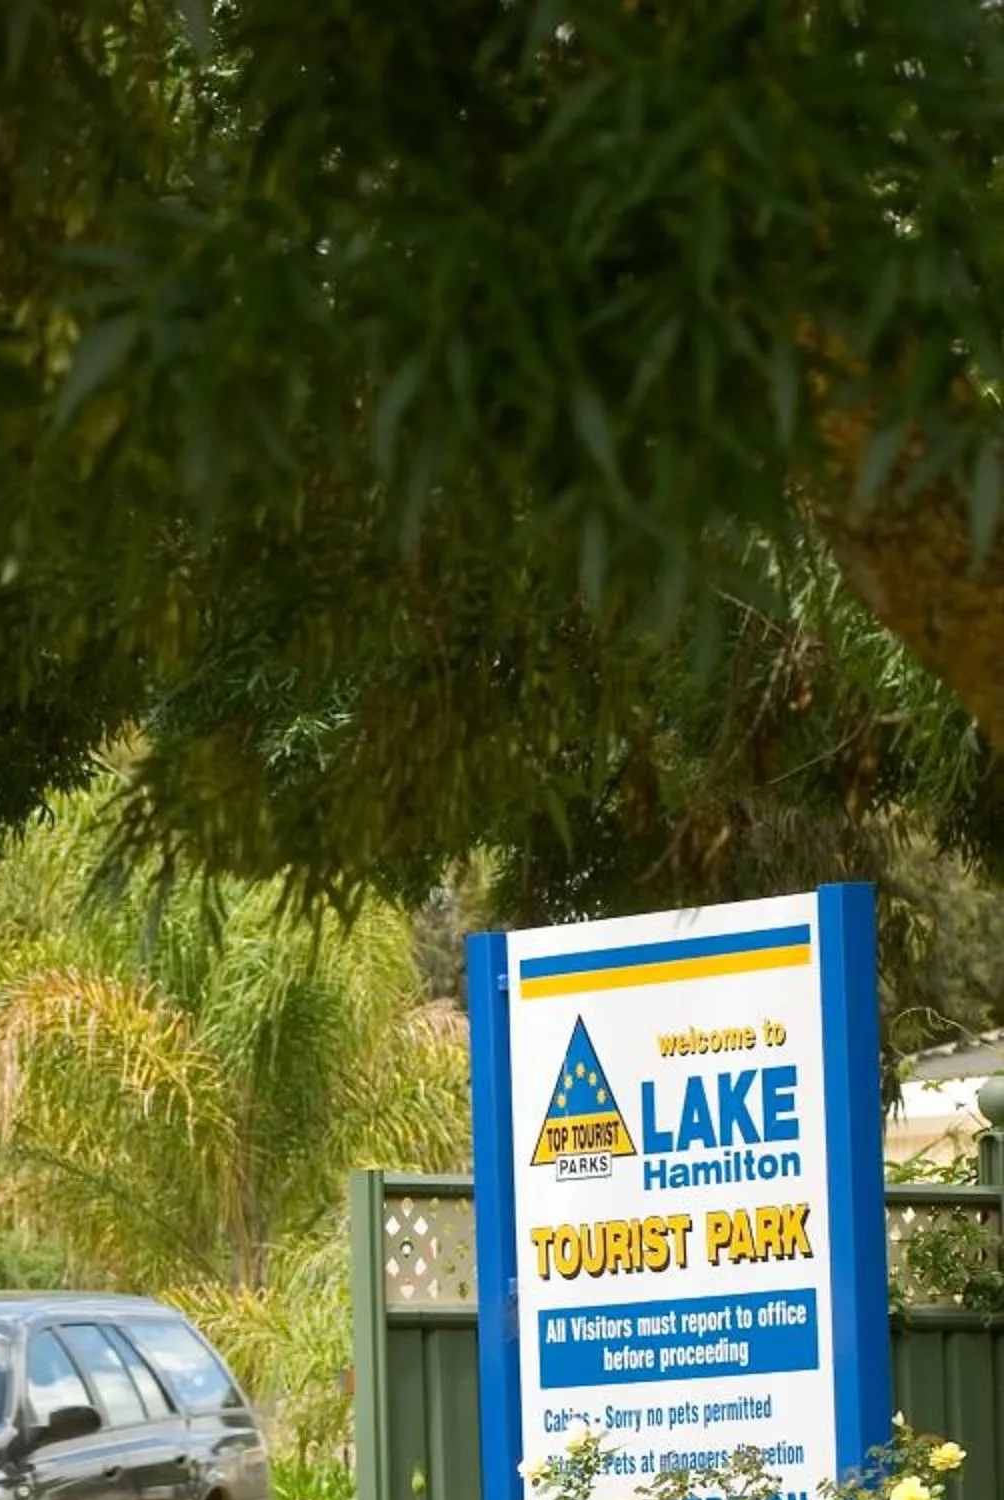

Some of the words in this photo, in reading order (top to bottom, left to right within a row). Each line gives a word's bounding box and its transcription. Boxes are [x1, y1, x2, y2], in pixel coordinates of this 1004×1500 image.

[656, 1025, 756, 1057] welcome
[762, 1020, 786, 1048] to
[641, 1065, 800, 1155] LAKE
[547, 1126, 568, 1152] TOP
[572, 1120, 619, 1149] TOURIST
[559, 1155, 608, 1175] PARKS
[643, 1151, 801, 1190] Hamilton
[530, 1213, 693, 1280] TOURIST
[706, 1203, 814, 1266] PARK
[546, 1317, 567, 1344] All
[570, 1315, 633, 1341] Visitors
[637, 1310, 677, 1337] must
[681, 1305, 732, 1338] report
[736, 1305, 753, 1329] to
[758, 1300, 807, 1328] office
[603, 1345, 655, 1371] before
[659, 1337, 749, 1372] proceeding
[544, 1407, 591, 1432] Cabis
[605, 1405, 642, 1432] Sorry
[647, 1407, 663, 1427] no
[668, 1401, 699, 1431] pets
[704, 1394, 772, 1428] permitted
[640, 1449, 655, 1473] at
[659, 1450, 728, 1474] managers
